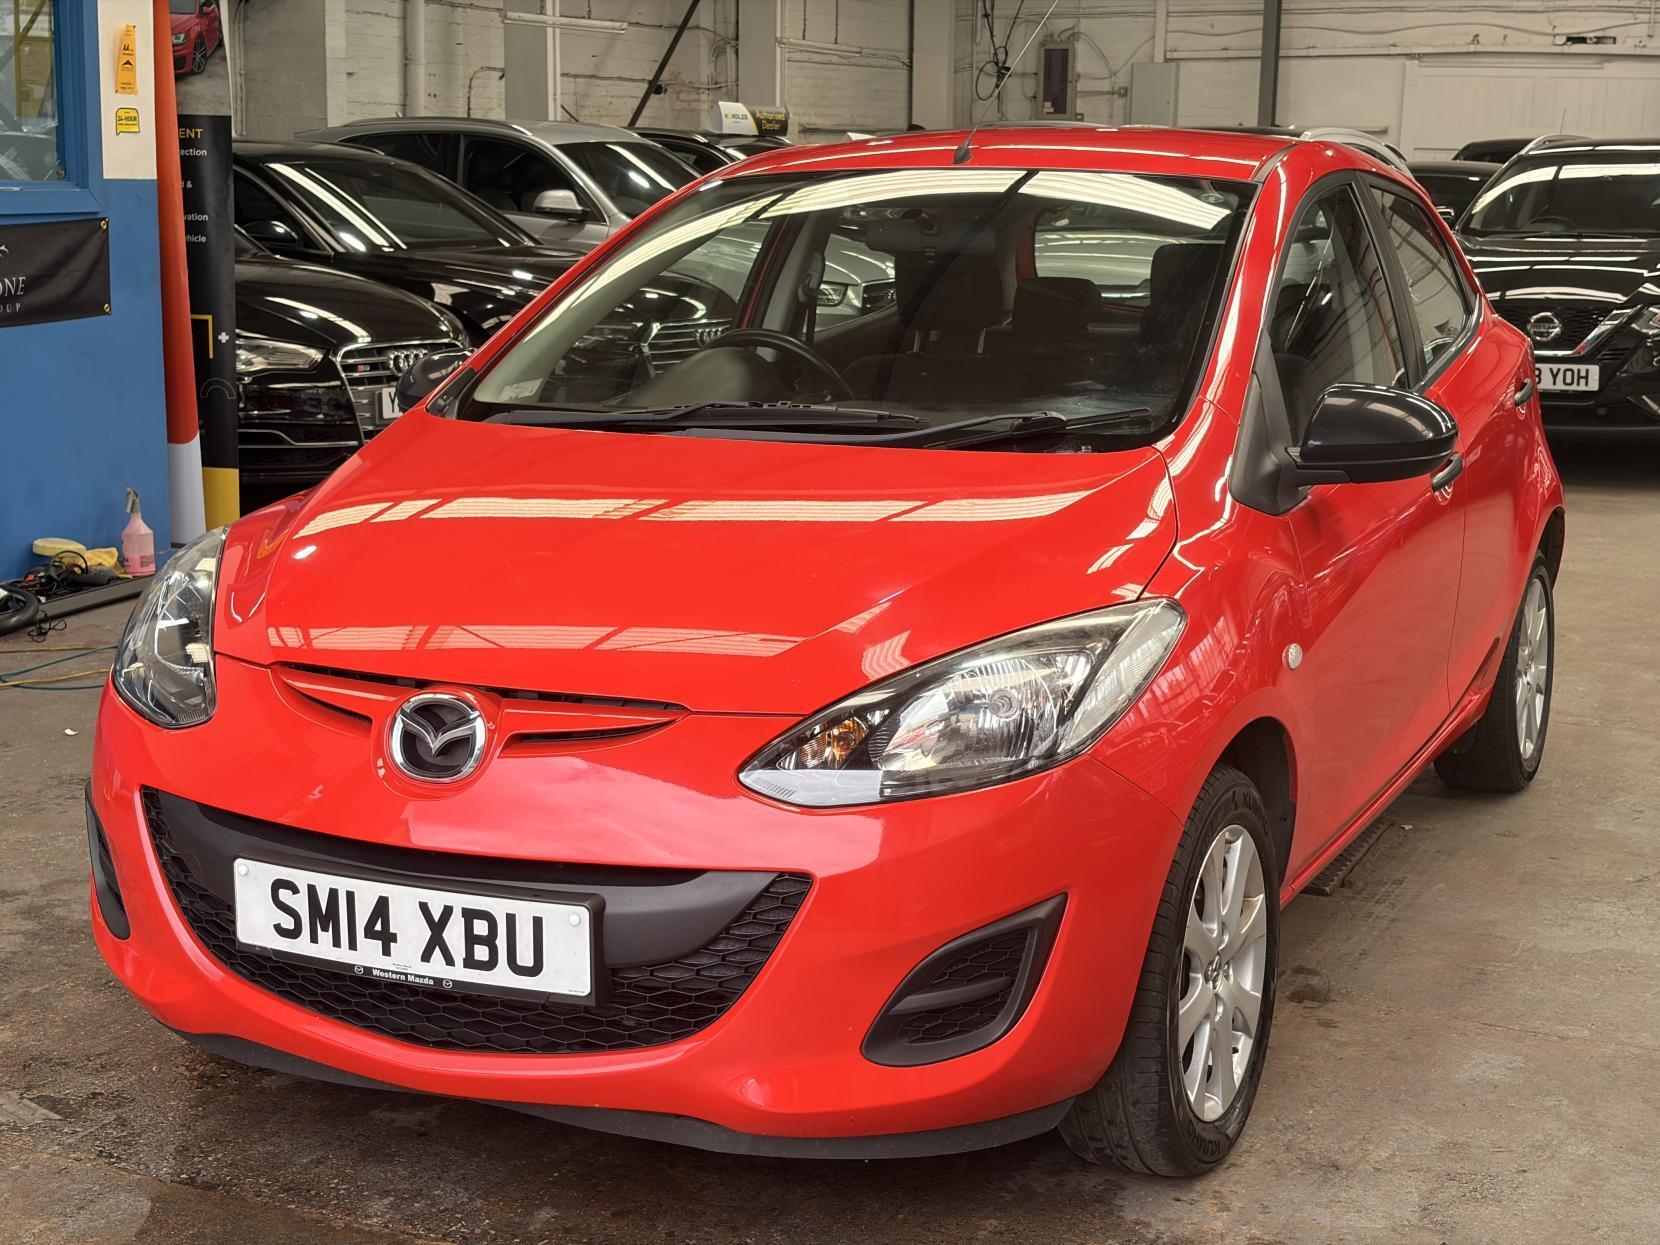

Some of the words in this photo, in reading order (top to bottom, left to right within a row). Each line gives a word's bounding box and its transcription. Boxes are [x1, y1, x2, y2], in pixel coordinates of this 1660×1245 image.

[762, 120, 781, 129] Dealer
[178, 128, 203, 139] ENT
[179, 148, 207, 156] ection
[184, 212, 208, 221] ation
[185, 234, 206, 243] hicle
[1549, 367, 1589, 387] YOH
[270, 878, 398, 957] SM14
[418, 901, 544, 978] XBU
[372, 968, 406, 981] Western
[407, 974, 434, 985] Mazda
